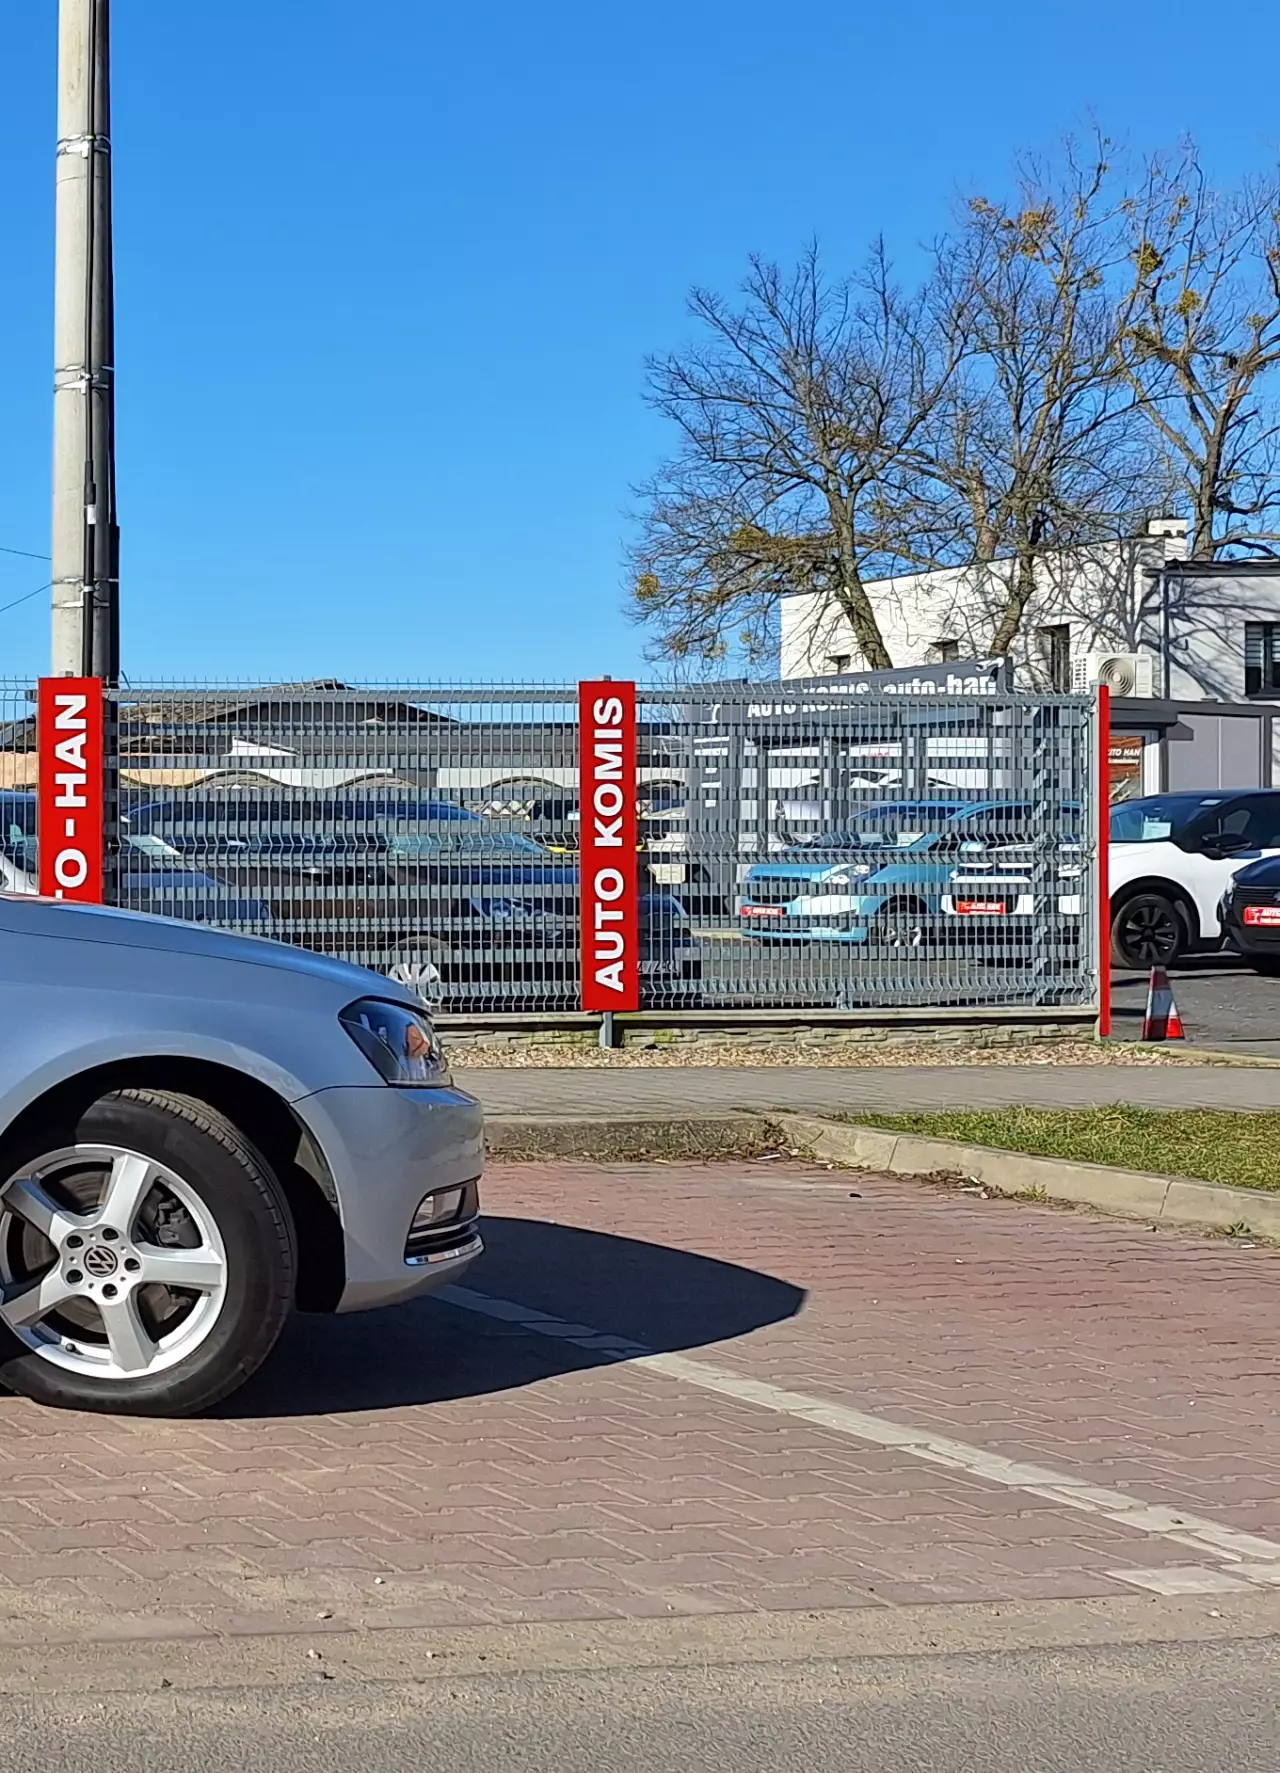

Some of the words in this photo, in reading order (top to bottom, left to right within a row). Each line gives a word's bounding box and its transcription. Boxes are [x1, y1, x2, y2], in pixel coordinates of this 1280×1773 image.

[55, 694, 88, 900] O-HAN
[593, 697, 624, 847] KOMIS
[594, 868, 625, 993] AUTO
